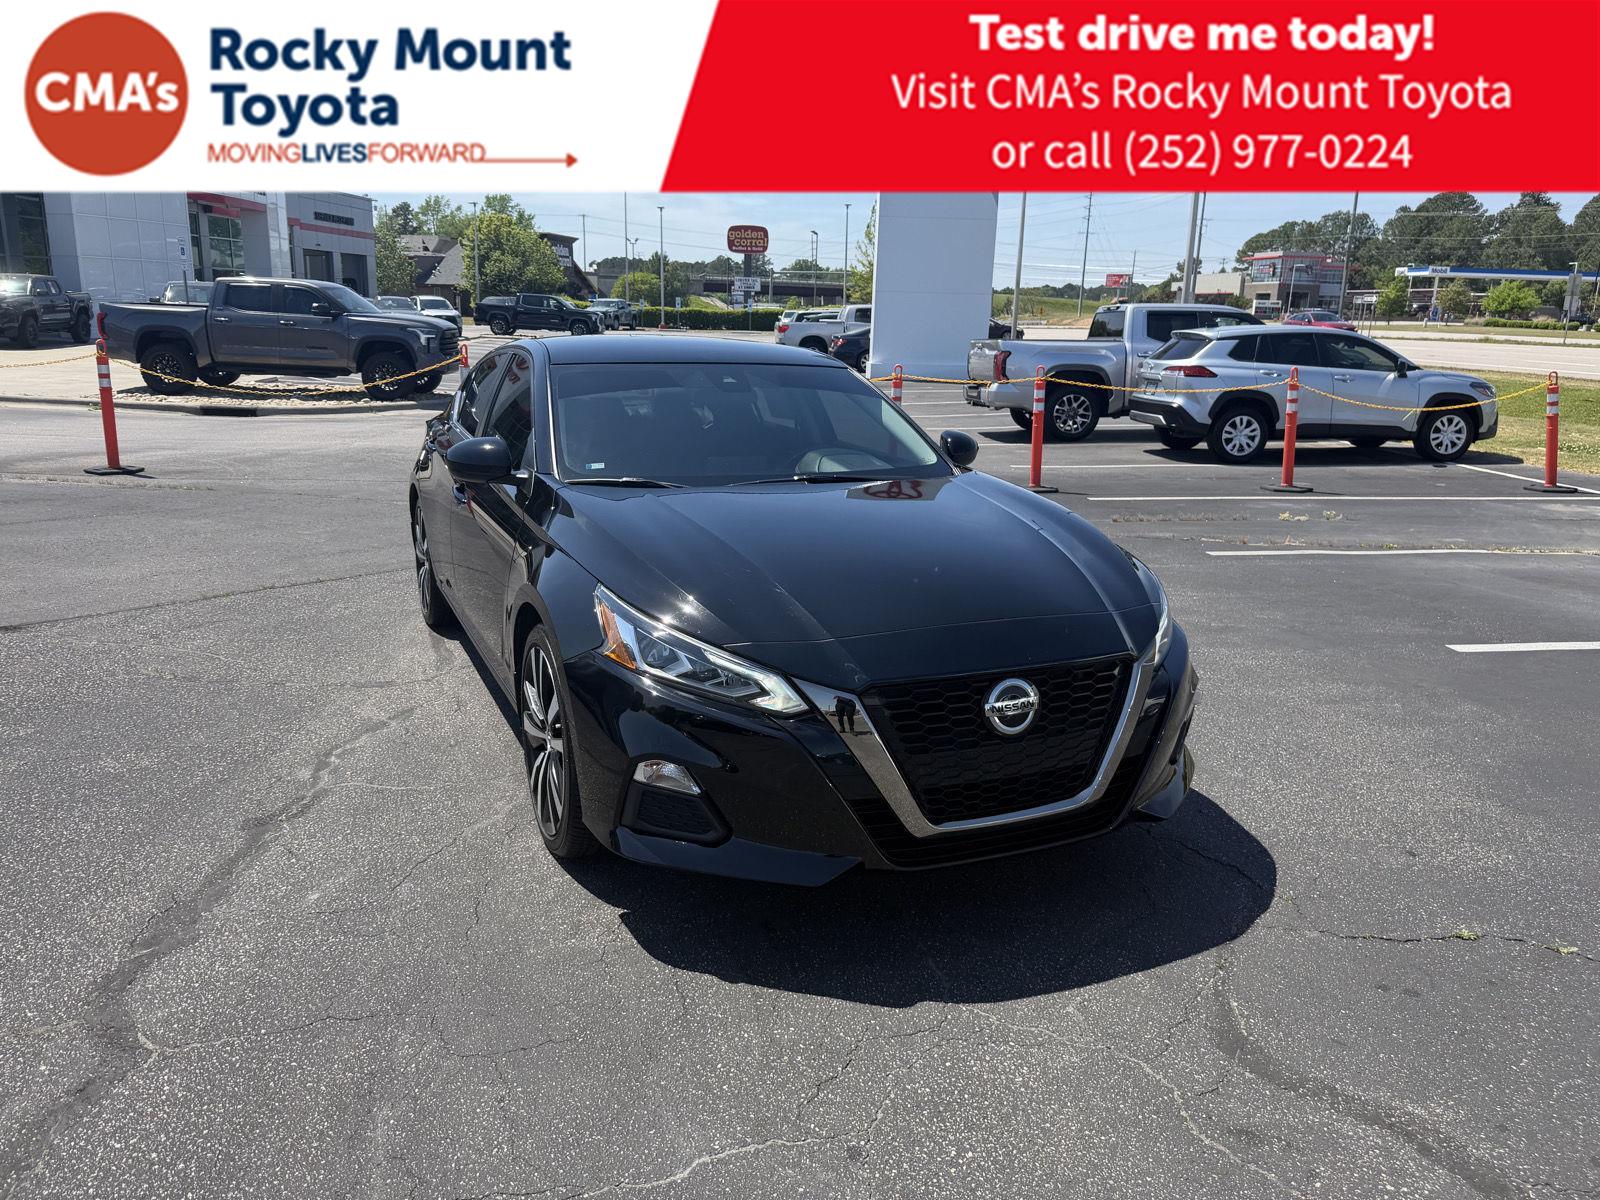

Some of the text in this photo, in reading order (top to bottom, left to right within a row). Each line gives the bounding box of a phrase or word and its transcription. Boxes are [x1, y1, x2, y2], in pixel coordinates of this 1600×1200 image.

[728, 229, 765, 240] golden
[734, 237, 768, 247] corral
[991, 700, 1035, 714] NISSAN
